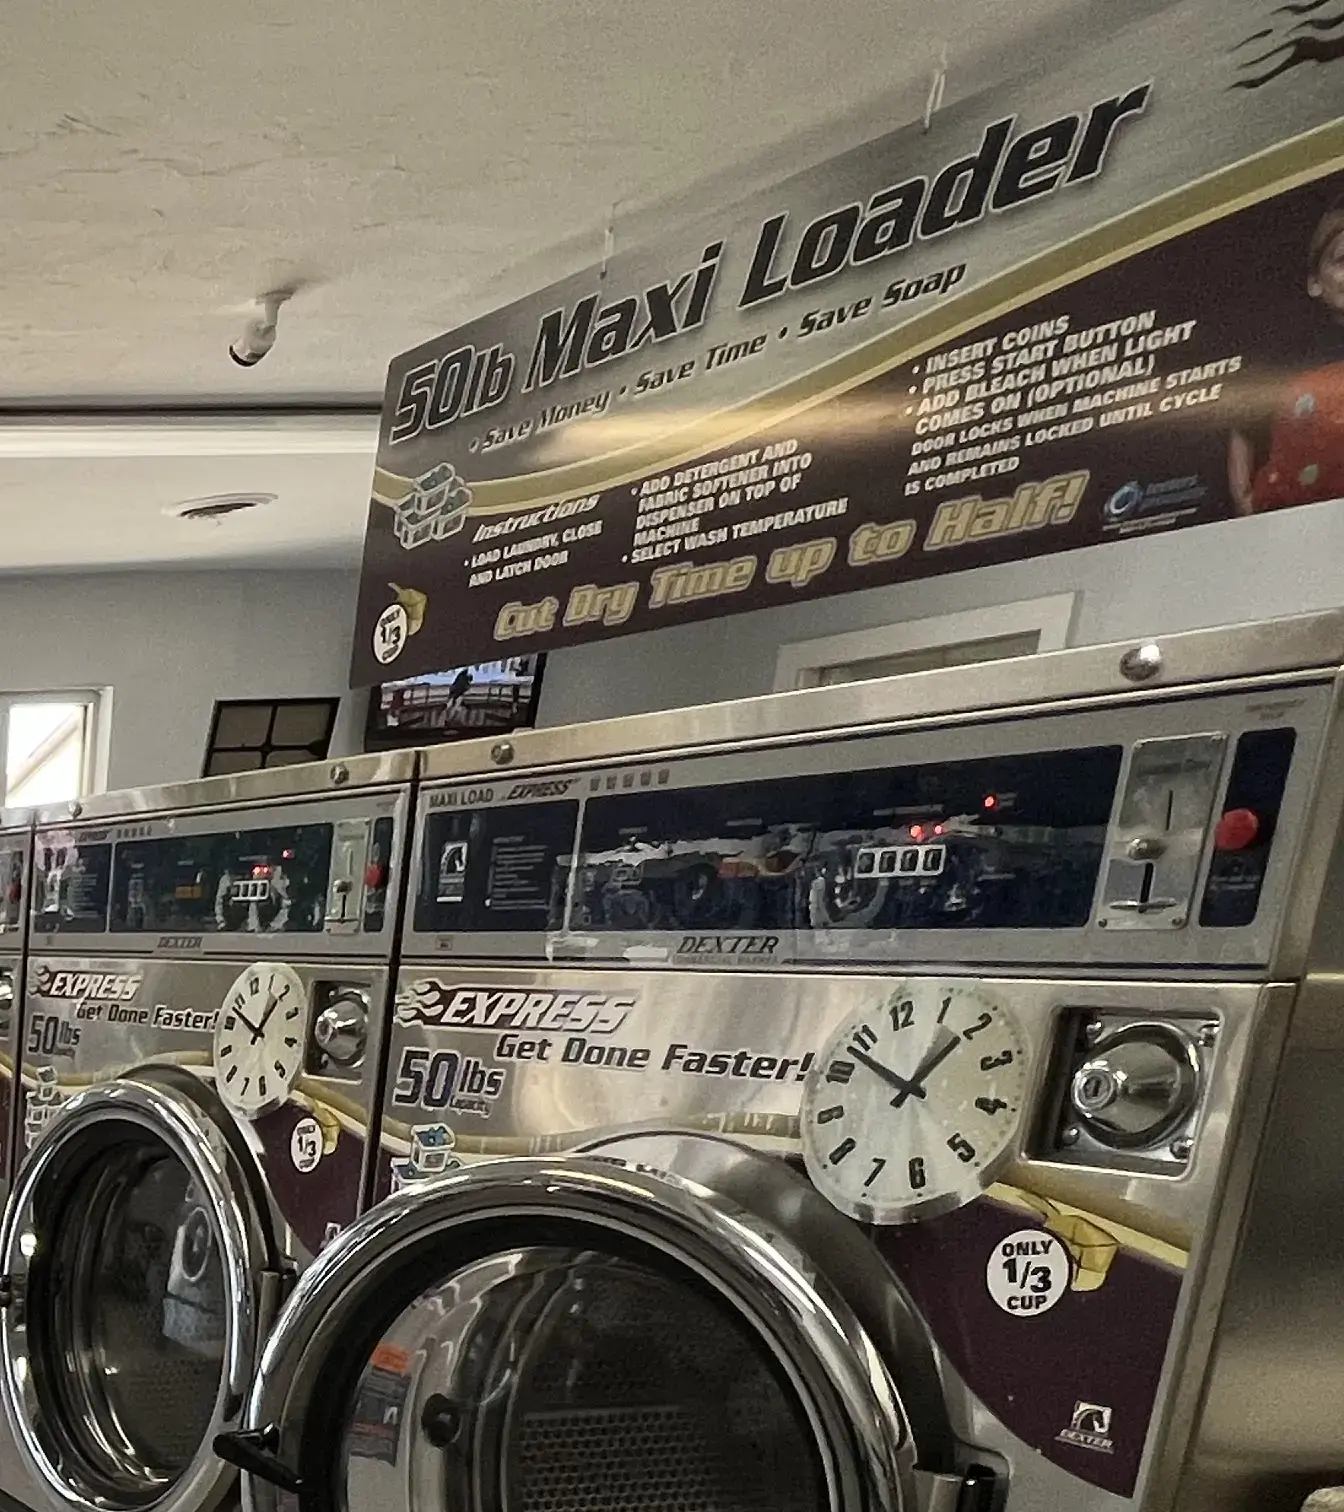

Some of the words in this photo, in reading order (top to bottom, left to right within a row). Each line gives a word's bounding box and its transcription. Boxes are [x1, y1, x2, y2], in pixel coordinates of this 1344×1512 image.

[389, 342, 515, 445] 50lb
[522, 241, 724, 393] Maxi
[738, 81, 1153, 308] Loader
[481, 421, 531, 454] Save
[535, 391, 610, 437] Money
[633, 358, 696, 398] Save
[703, 330, 765, 374] Time
[797, 292, 874, 339] Save
[881, 262, 967, 312] Soap
[923, 362, 986, 395] PRESS
[990, 339, 1059, 374] START
[1064, 310, 1157, 349] BUTTON
[926, 337, 998, 374] INSERT
[1002, 315, 1070, 351] COINS
[917, 389, 960, 416] ADD
[965, 365, 1047, 402] BLEACH
[1051, 346, 1117, 378] WHEN
[1124, 320, 1197, 356] LIGHT
[912, 433, 956, 457] DOOR
[960, 418, 1012, 444] LOCKS
[1017, 402, 1067, 428] WHEN
[1072, 378, 1160, 414] MACHINE
[1165, 356, 1242, 390] STARTS
[915, 404, 985, 436] COMES
[991, 392, 1021, 414] ON
[1027, 353, 1156, 409] (OPTIONAL)
[907, 456, 941, 477] AND
[944, 437, 1020, 468] REMAINS
[1025, 416, 1094, 447] LOCKED
[1099, 400, 1154, 428] UNTIL
[1160, 384, 1223, 413] CYCLE
[638, 487, 689, 514] FABRIC
[693, 466, 770, 502] SOFTENER
[772, 452, 812, 474] INTO
[641, 475, 669, 496] ADD
[673, 451, 758, 487] DETERGENT
[760, 438, 798, 464] AND
[904, 480, 920, 497] IS
[924, 457, 1020, 492] COMPLETED
[471, 494, 601, 544] Instructions
[636, 496, 714, 530] DISPENSER
[718, 491, 741, 510] ON
[745, 481, 776, 502] TOP
[780, 473, 803, 492] OF
[631, 538, 681, 564] SELECT
[684, 528, 727, 552] WASH
[732, 498, 849, 540] TEMPERATURE
[634, 517, 700, 547] MACHINE
[493, 595, 560, 641] Cut
[563, 580, 640, 628] Dry
[648, 554, 758, 610] Time
[764, 536, 838, 588] up
[847, 518, 917, 567] to
[923, 469, 1091, 551] Half!
[428, 792, 458, 808] MAXI
[461, 787, 495, 805] LOAD
[506, 778, 574, 800] EXPRESS
[157, 936, 202, 949] DEXTER
[676, 935, 779, 954] DEXTER
[48, 971, 143, 1001] EXPRESS
[76, 1001, 103, 1021] Get
[107, 1004, 149, 1025] Done
[153, 1005, 220, 1033] Faster!
[439, 989, 637, 1033] EXPRESS
[889, 1000, 915, 1031] 12
[936, 996, 952, 1024] 1
[963, 1012, 993, 1040] 2
[27, 1014, 60, 1056] 50
[59, 1021, 82, 1046] lbs
[853, 1024, 878, 1051] 11
[495, 1032, 553, 1063] Get
[560, 1036, 651, 1069] Done
[660, 1043, 817, 1083] Faster!
[825, 1060, 855, 1084] 10
[980, 1050, 1013, 1071] 3
[393, 1047, 460, 1110] 50
[458, 1057, 507, 1099] lbs
[975, 1097, 1007, 1115] 4
[946, 1132, 976, 1162] 5
[864, 1157, 887, 1187] 7
[908, 1156, 926, 1190] 6
[1000, 1239, 1055, 1258] ONLY
[1001, 1257, 1053, 1293] 1/3
[1006, 1294, 1049, 1311] CUP
